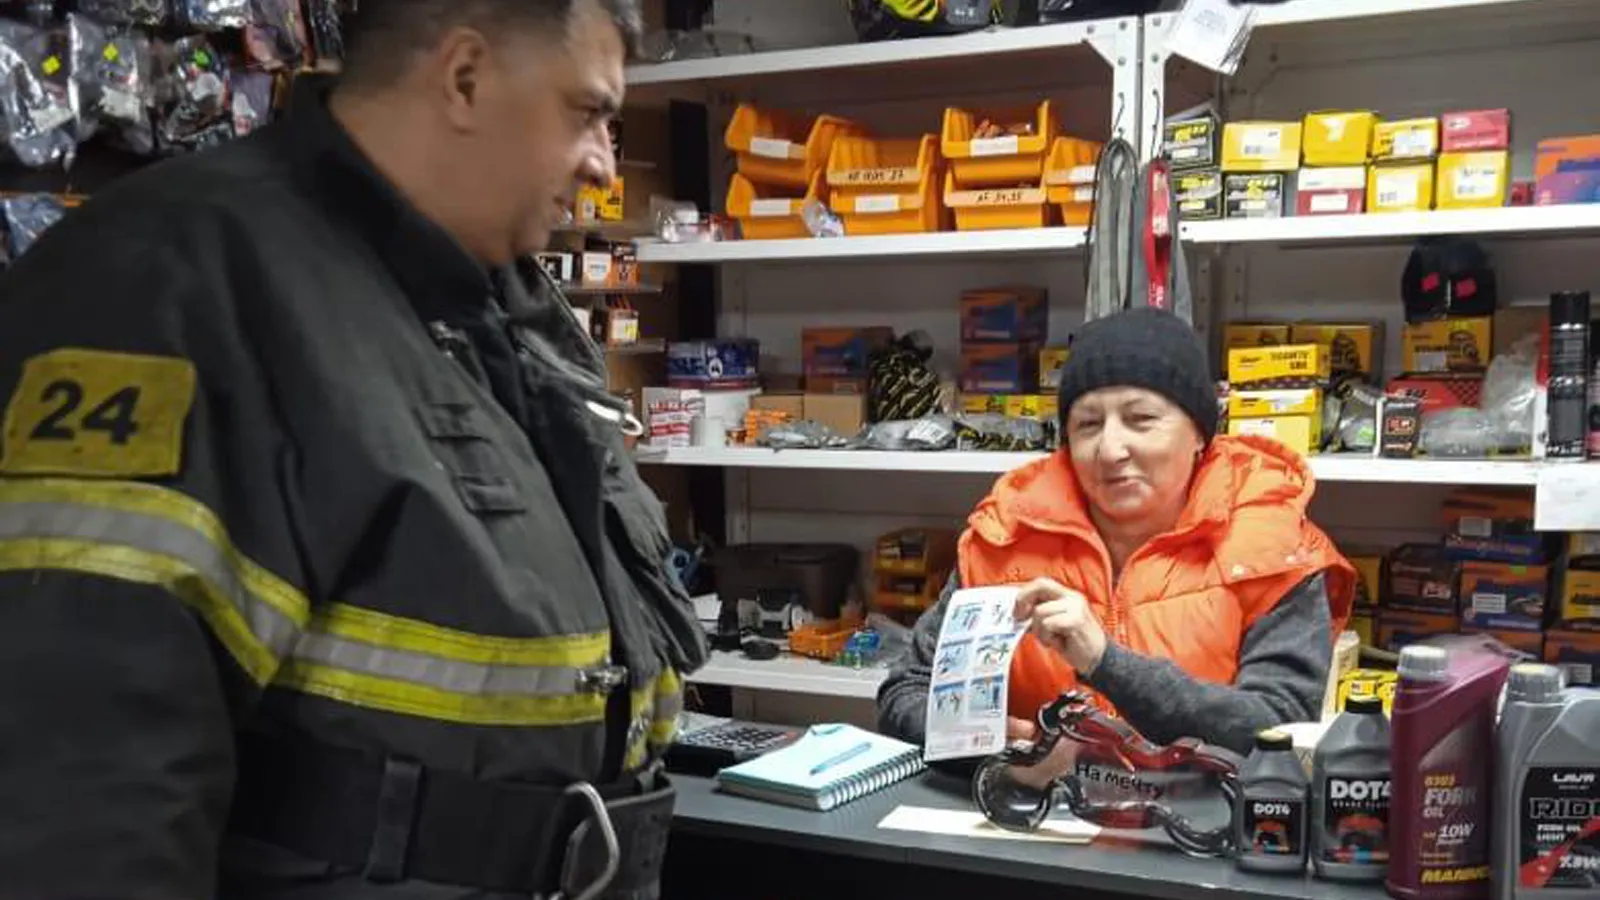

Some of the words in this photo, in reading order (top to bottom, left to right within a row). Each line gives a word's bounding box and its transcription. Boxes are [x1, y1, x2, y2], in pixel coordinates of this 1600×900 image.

[30, 379, 141, 444] 24
[1075, 763, 1101, 781] На
[1253, 802, 1292, 816] DOT4
